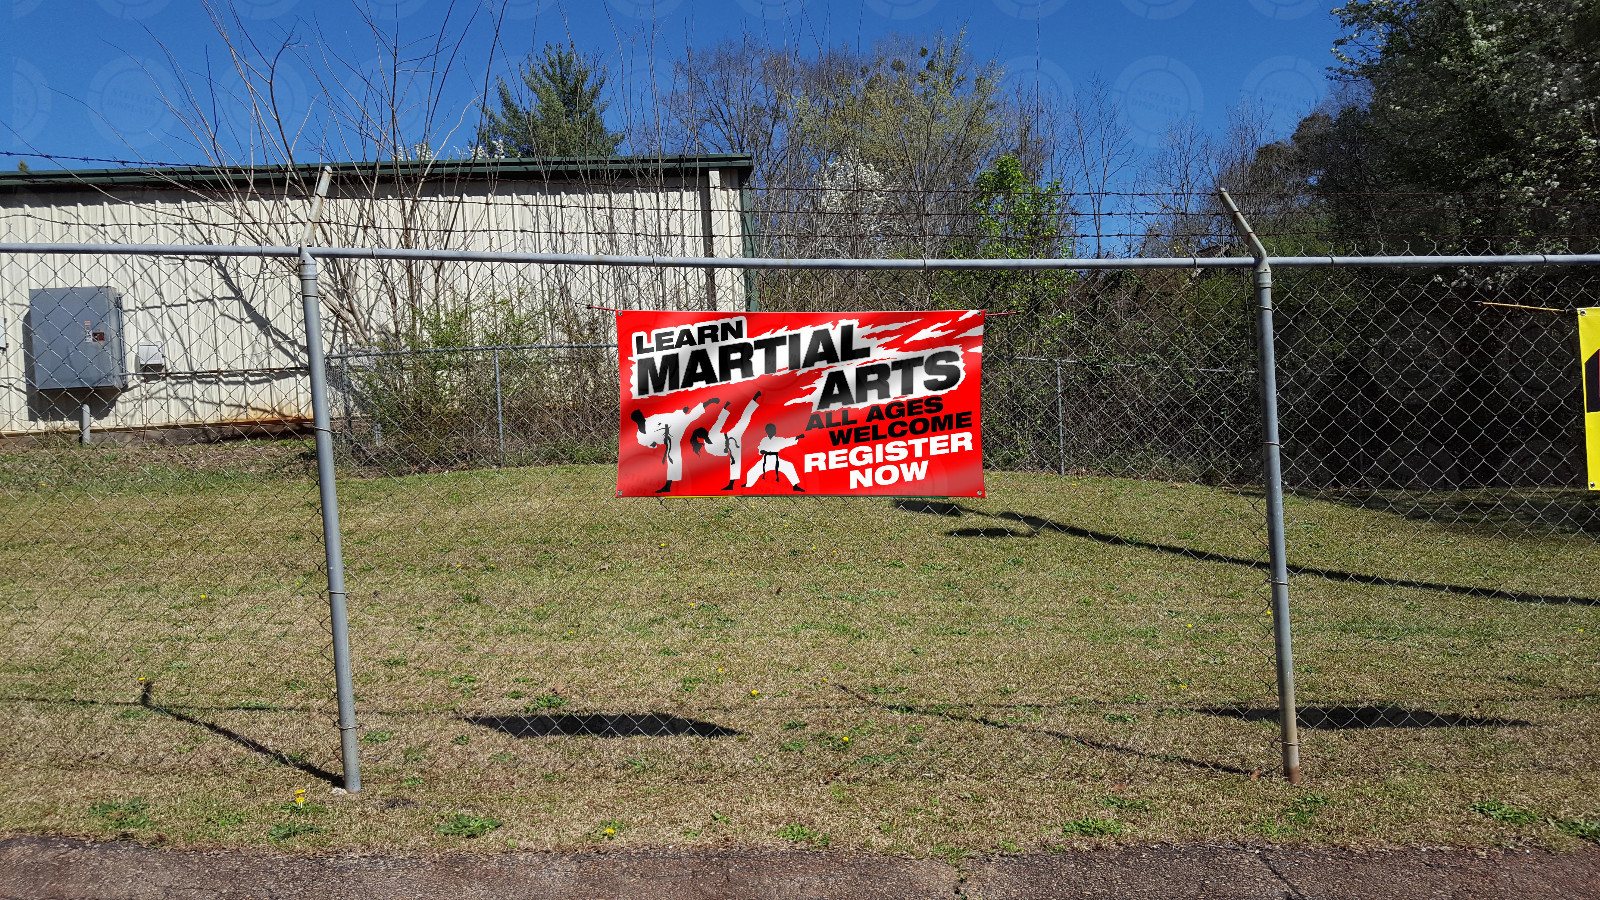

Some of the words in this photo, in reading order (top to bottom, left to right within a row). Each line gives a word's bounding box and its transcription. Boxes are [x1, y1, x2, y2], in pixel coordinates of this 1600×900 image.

[635, 320, 743, 354] LEARN
[637, 325, 870, 397] MARTIAL
[816, 351, 961, 410] ARTS
[805, 413, 858, 431] ALL
[865, 396, 944, 423] AGES
[829, 411, 972, 447] WELCOME
[803, 432, 973, 473] REGISTER
[849, 460, 929, 490] NOW
